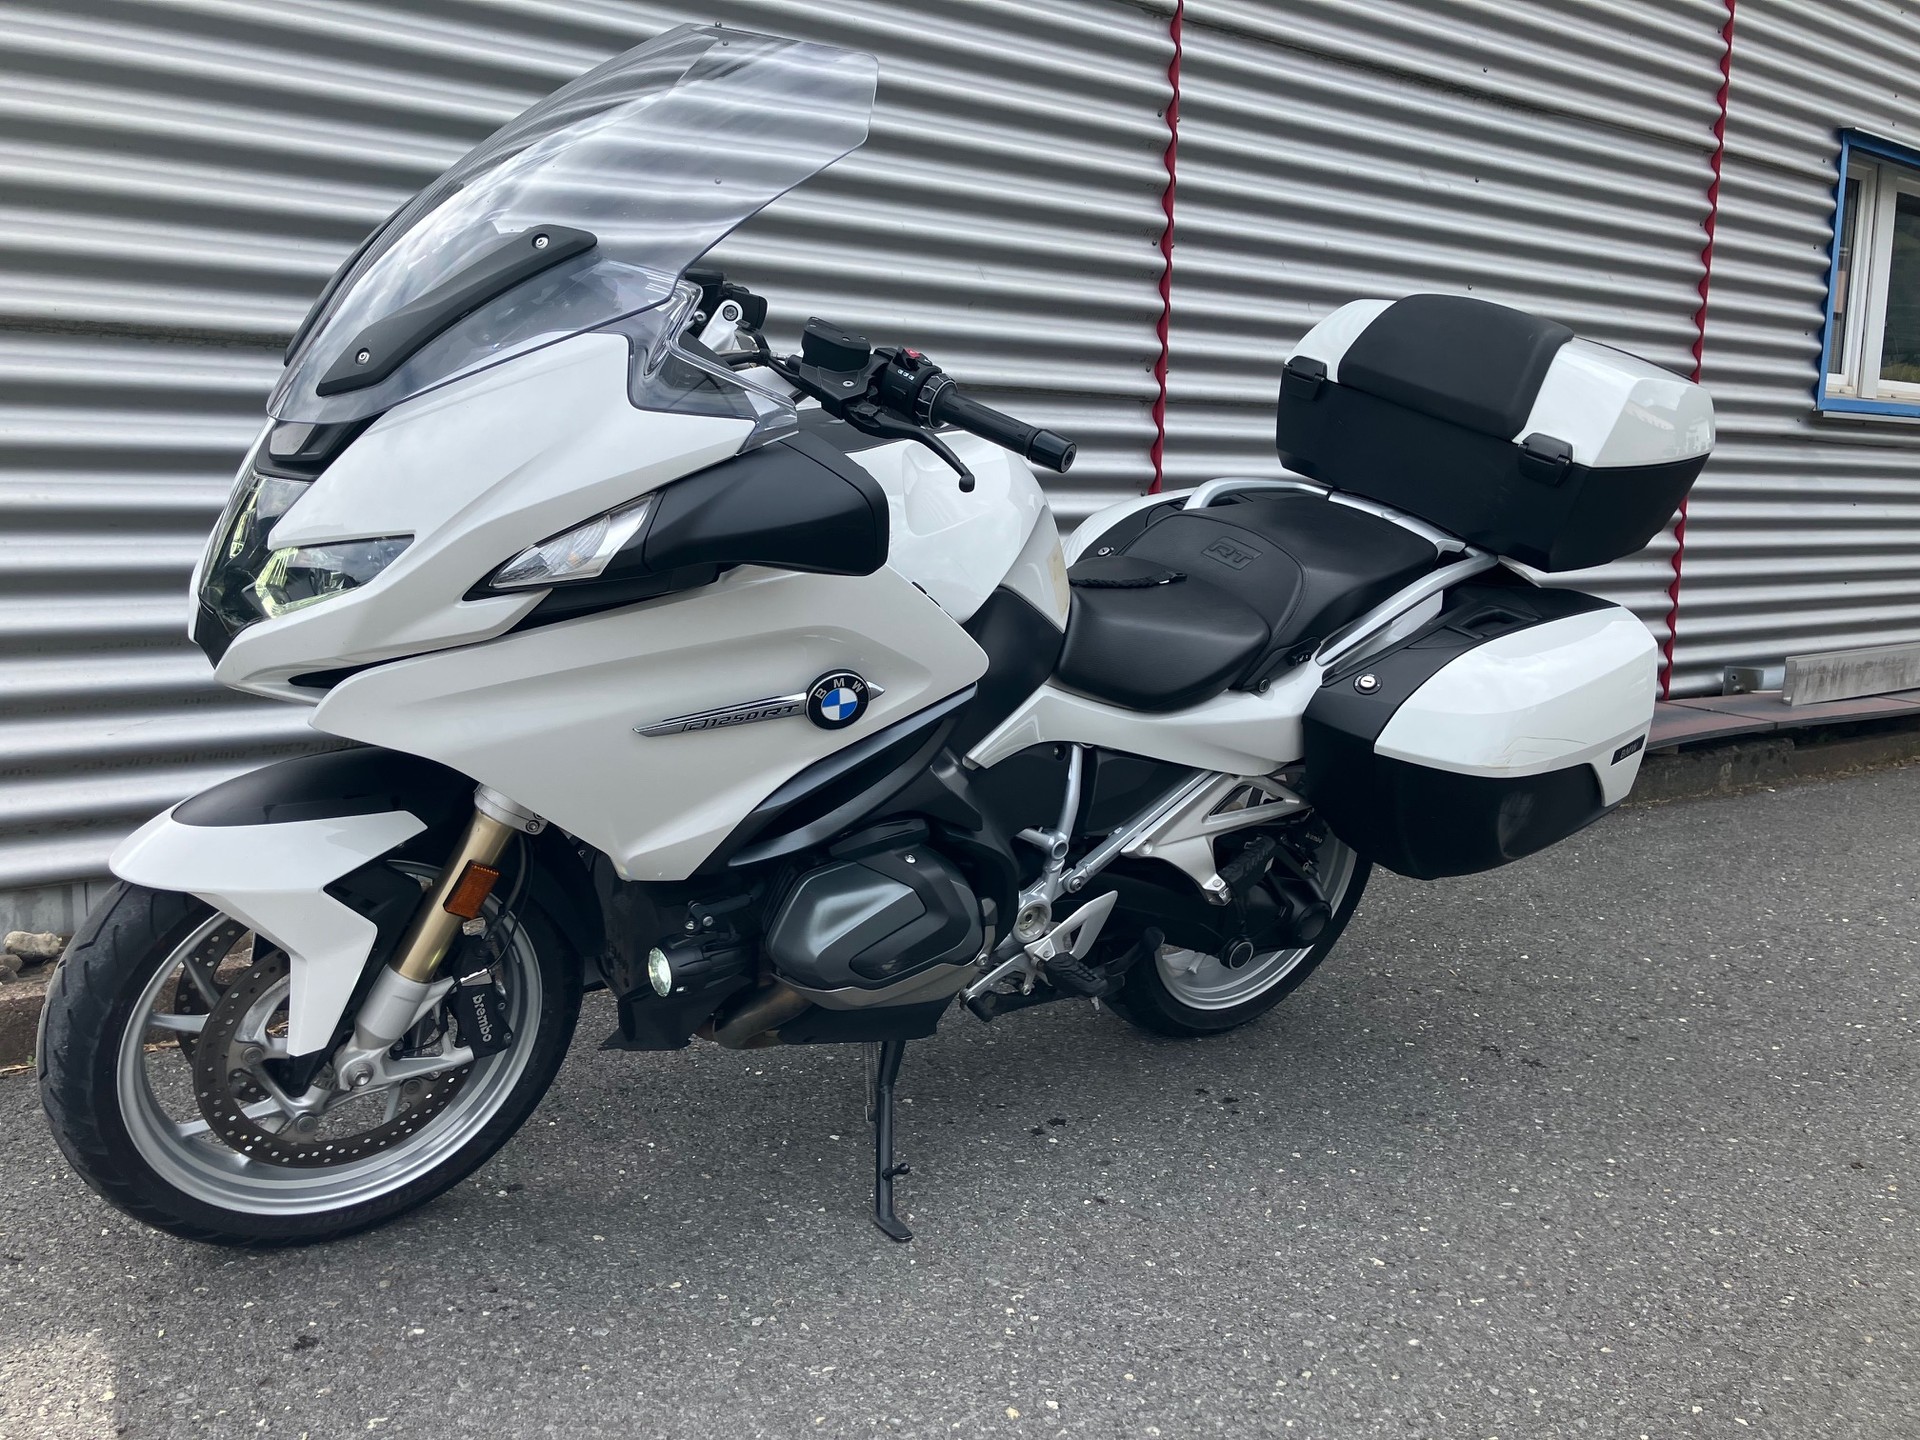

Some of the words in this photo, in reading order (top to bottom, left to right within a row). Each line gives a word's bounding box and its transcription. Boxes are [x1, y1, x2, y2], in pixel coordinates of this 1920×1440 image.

[1206, 541, 1254, 563] RT
[814, 677, 865, 699] BMW
[472, 993, 492, 1042] brembo
